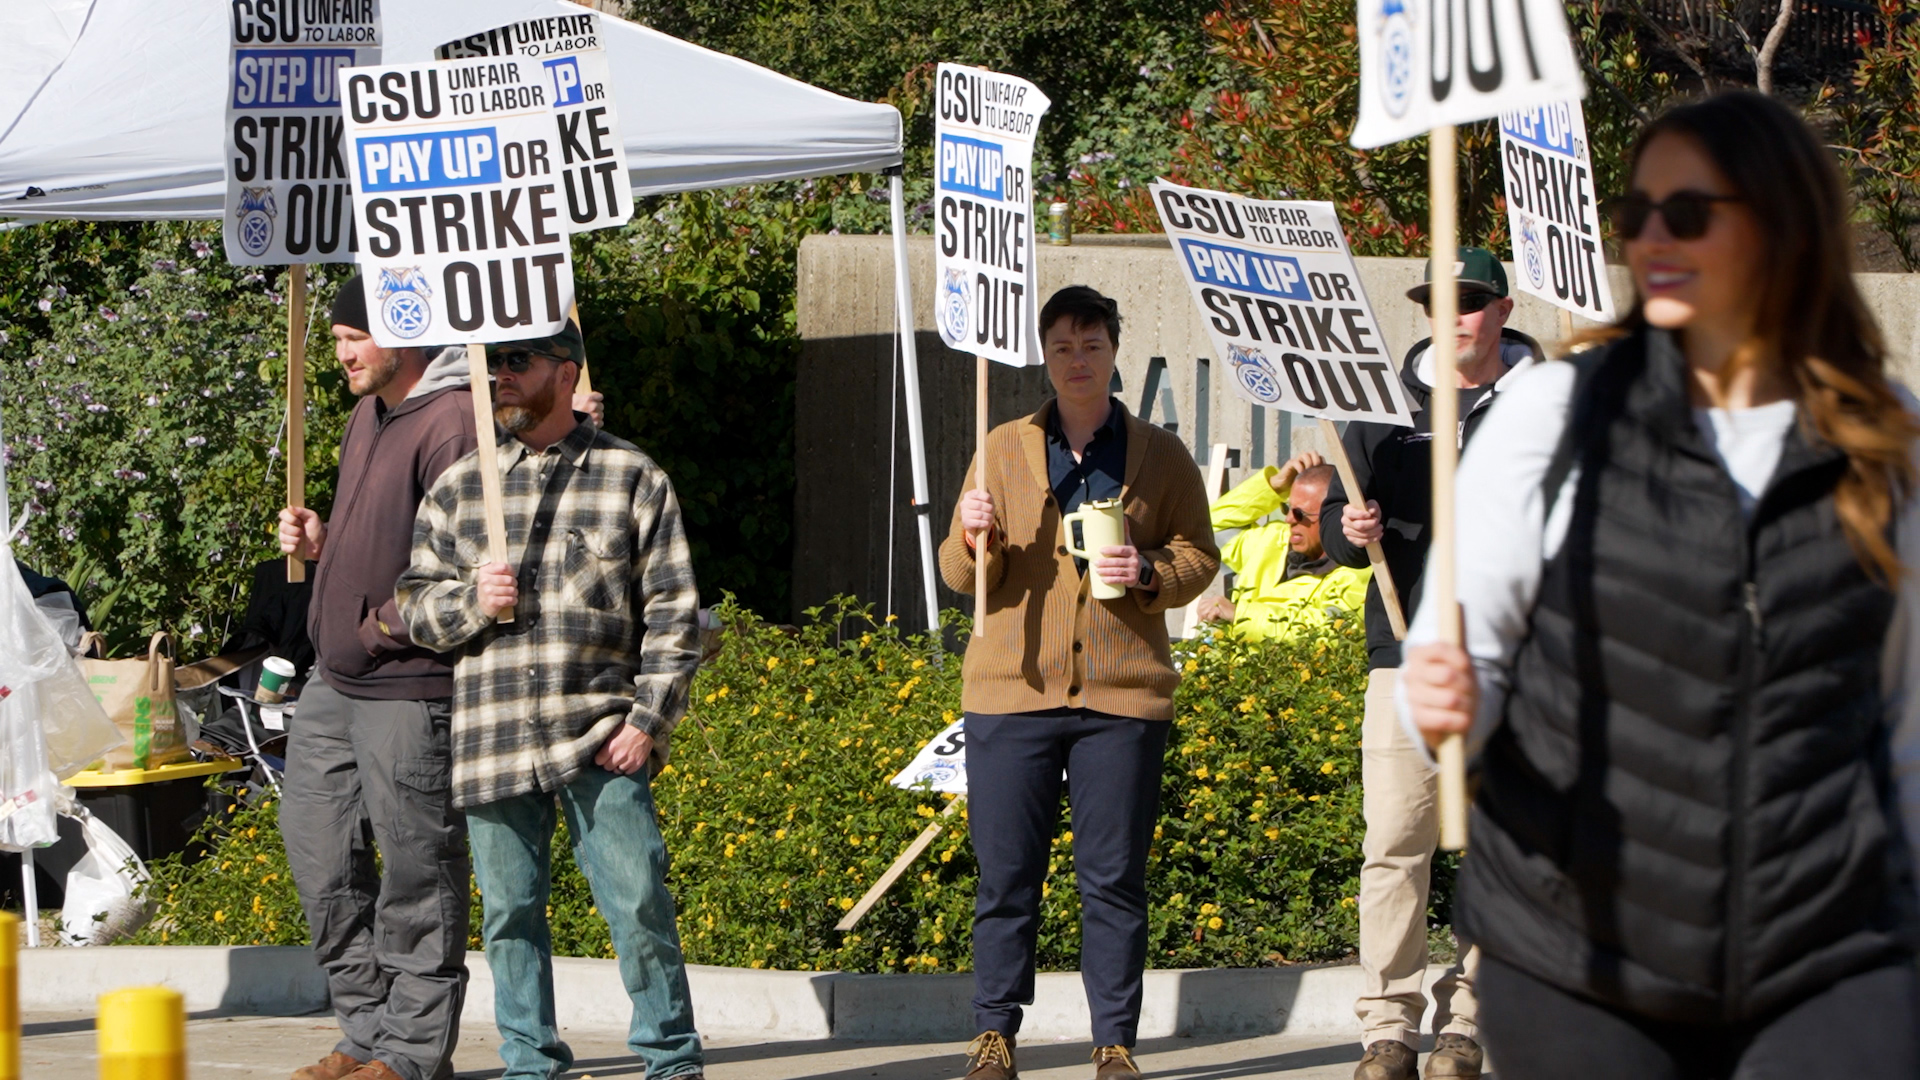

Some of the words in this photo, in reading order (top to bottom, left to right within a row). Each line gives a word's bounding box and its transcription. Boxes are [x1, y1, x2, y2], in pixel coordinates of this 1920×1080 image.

[232, 0, 299, 43] CSU
[304, 0, 373, 25] UNFAIR
[304, 27, 324, 42] TO
[328, 27, 375, 42] LABOR
[515, 15, 594, 44] UNFAIR
[519, 45, 540, 57] TO
[545, 36, 598, 53] LABOR
[237, 56, 307, 104] STEP
[349, 69, 441, 124] CSU
[448, 62, 520, 90] UNFAIR
[450, 93, 474, 115] TO
[480, 85, 545, 112] LABOR
[585, 83, 605, 101] OR
[941, 70, 981, 125] CSU
[985, 80, 1028, 107] UNFAIR
[985, 105, 996, 128] TO
[998, 108, 1034, 135] LABOR
[234, 116, 348, 182] STRIK
[363, 139, 433, 185] PAY
[440, 135, 493, 179] UP
[503, 139, 551, 179] OR
[1573, 137, 1587, 161] OR
[562, 161, 618, 224] UT
[1005, 165, 1025, 203] OR
[1505, 139, 1592, 236] STRIKE
[365, 184, 560, 258] STRIKE
[941, 196, 1024, 273] STRIKE
[1159, 190, 1245, 239] CSU
[1243, 205, 1311, 227] UNFAIR
[1249, 225, 1274, 244] TO
[1276, 228, 1339, 248] LABOR
[1187, 244, 1250, 286] PAY
[1251, 257, 1300, 294] UP
[1307, 272, 1356, 301] OR
[1547, 224, 1602, 312] OUT
[443, 253, 565, 332] OUT
[976, 273, 1024, 353] OUT
[1201, 288, 1379, 355] STRIKE
[1281, 353, 1398, 415] OUT
